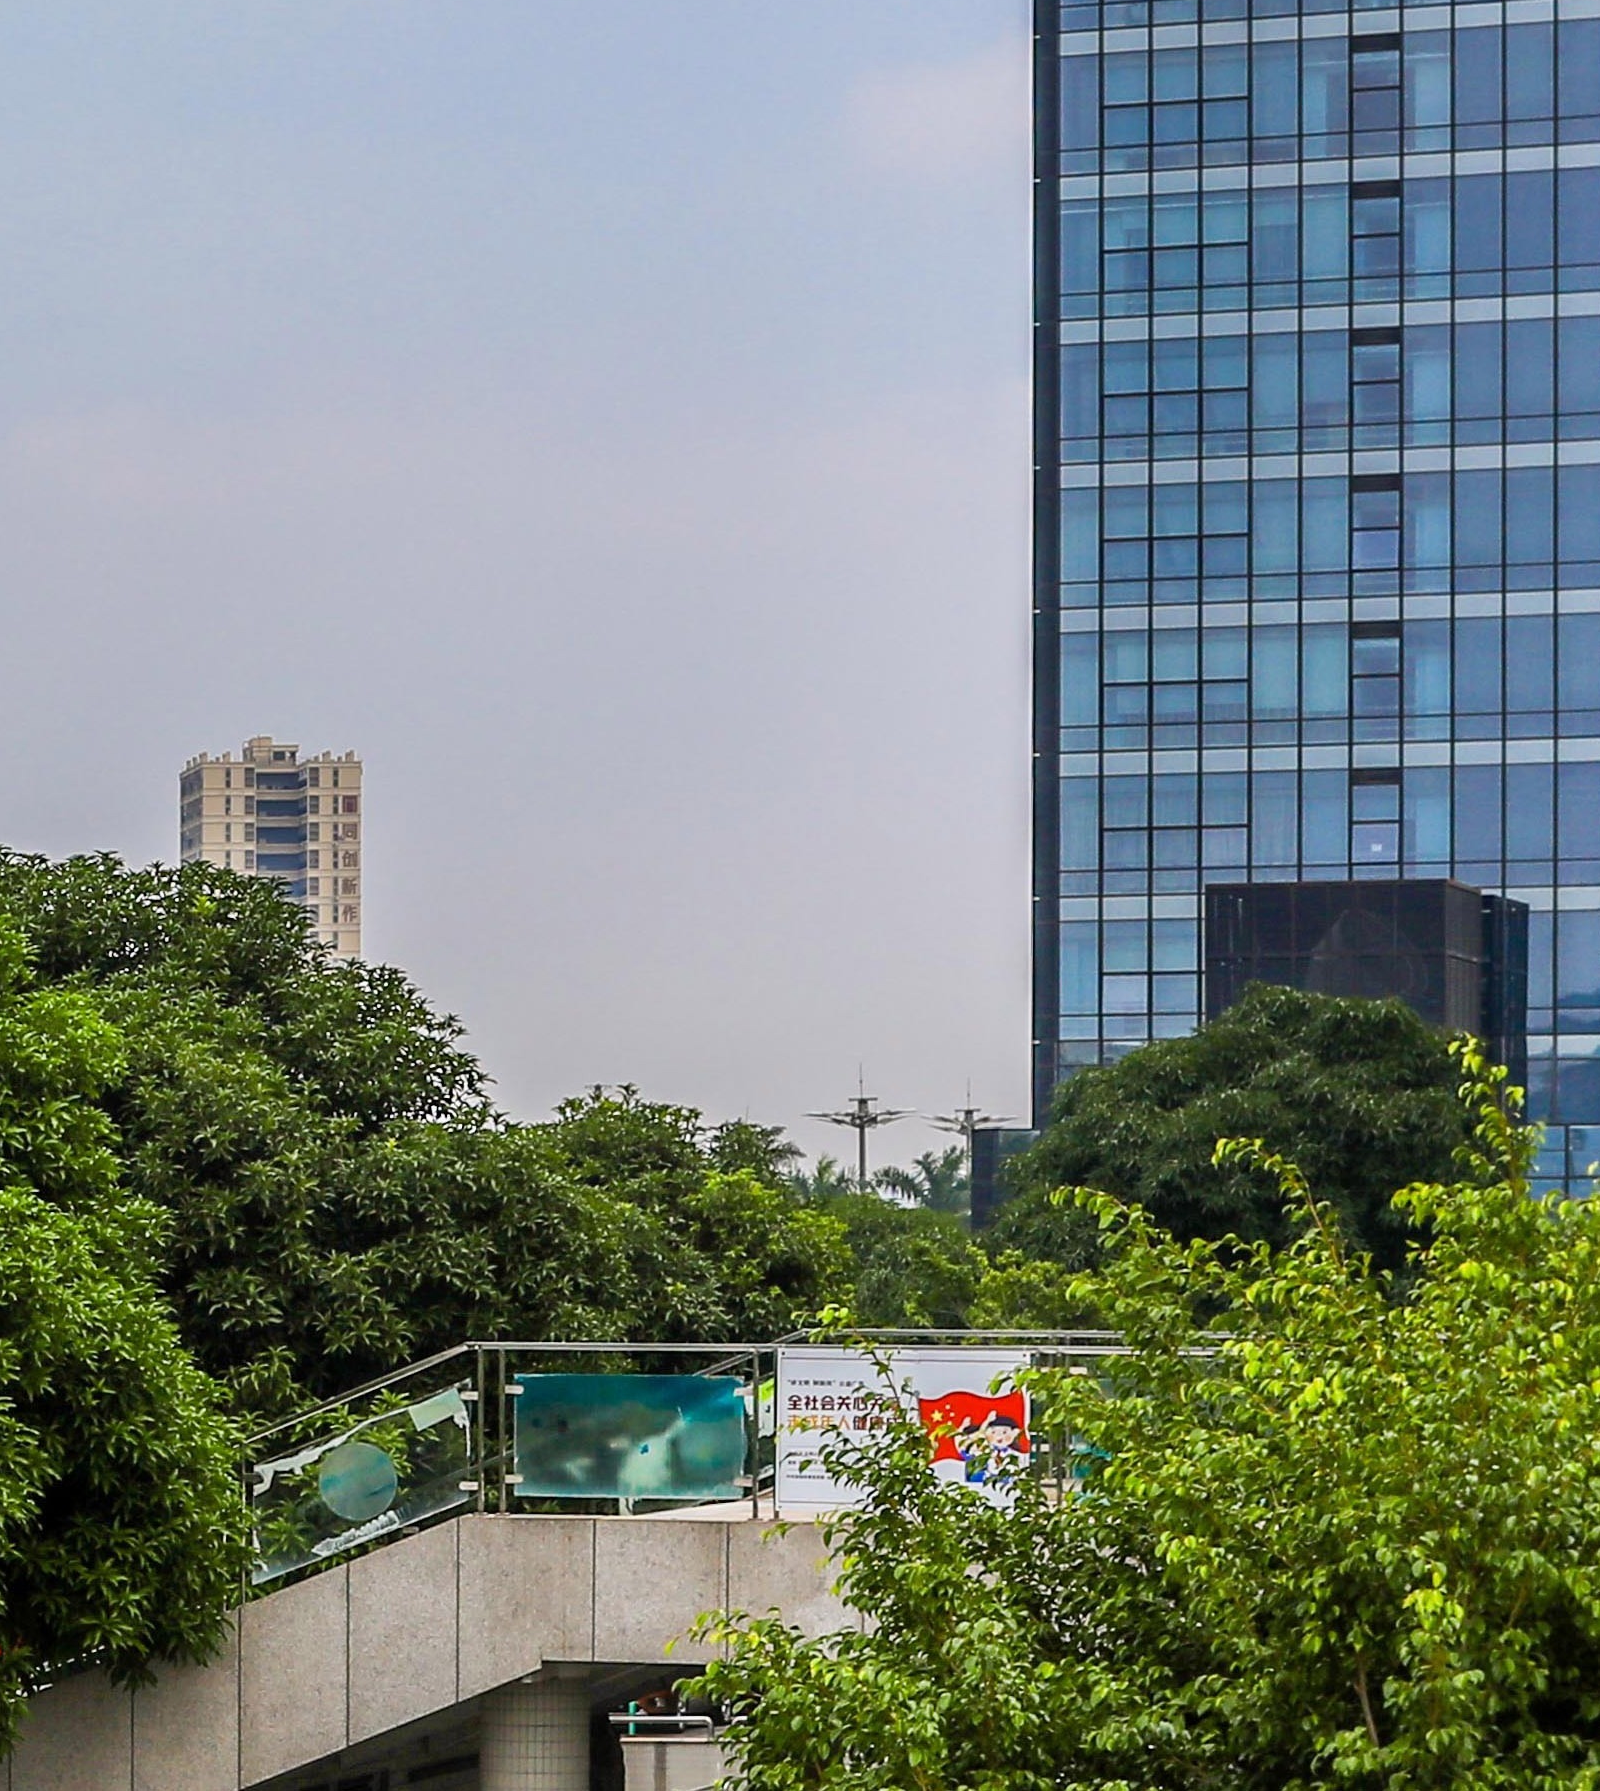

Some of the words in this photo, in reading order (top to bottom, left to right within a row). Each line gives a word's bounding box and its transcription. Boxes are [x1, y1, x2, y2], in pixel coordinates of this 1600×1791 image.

[788, 1394, 900, 1412] 全社会关心关
